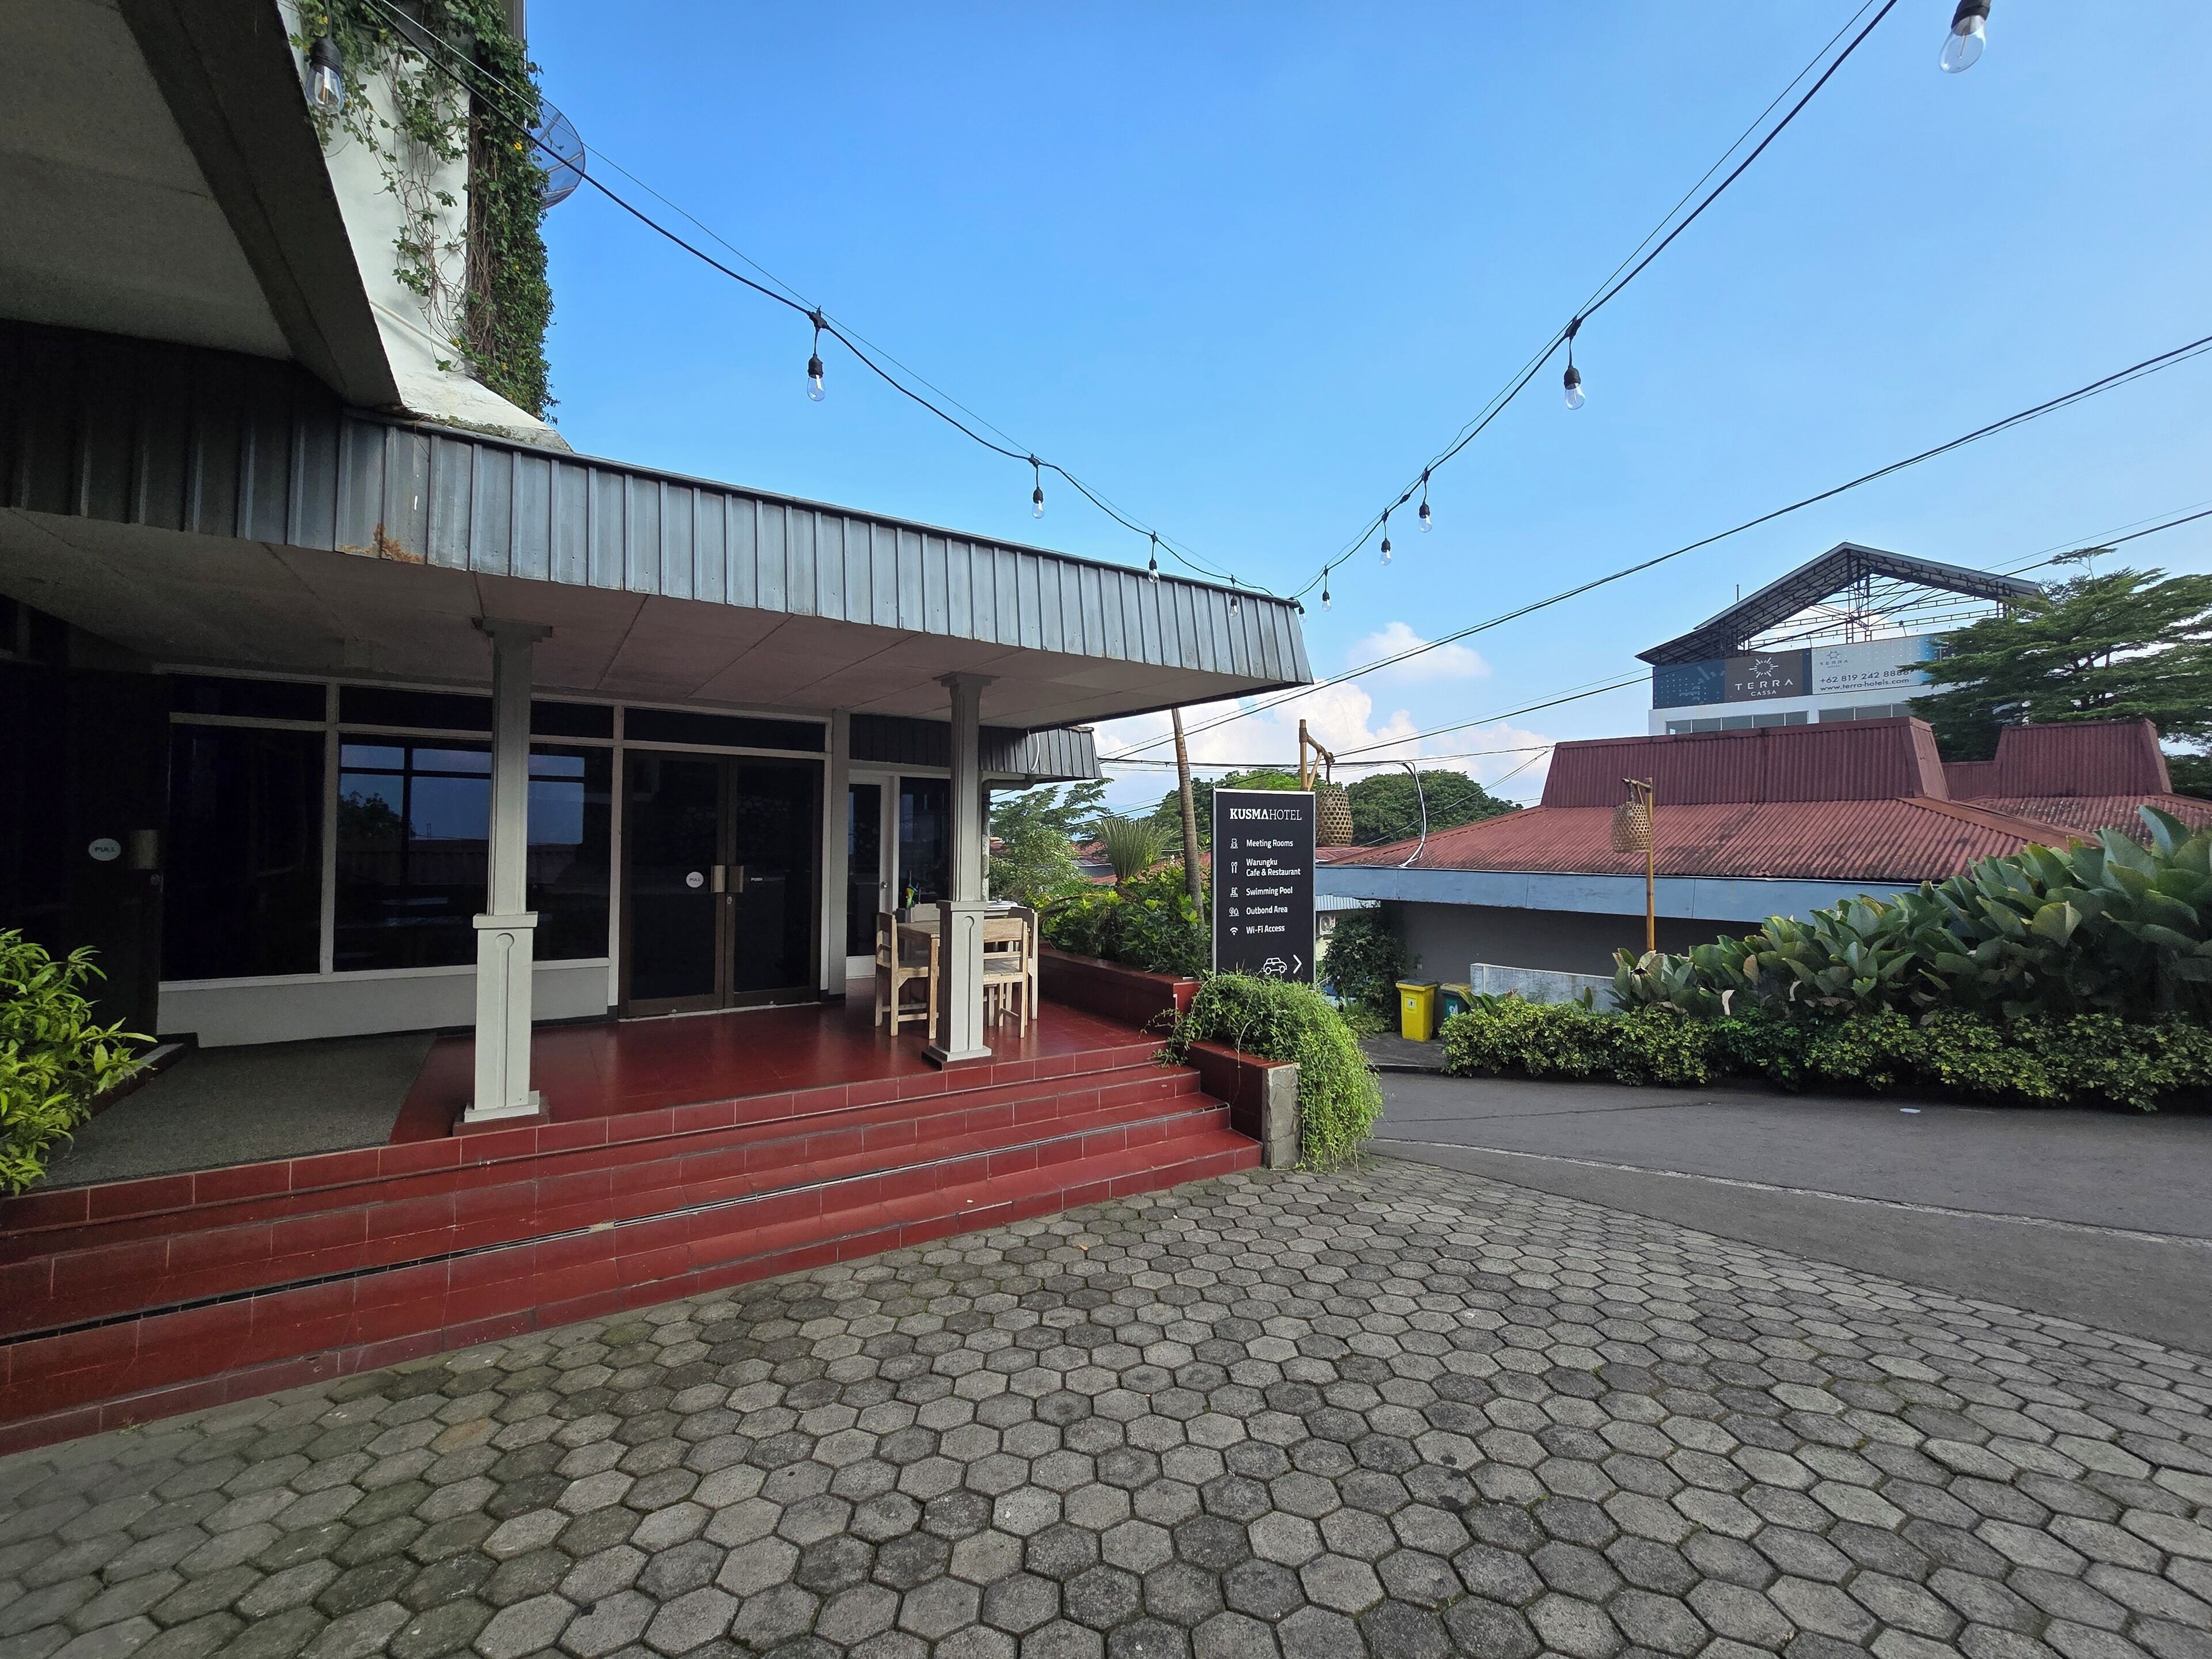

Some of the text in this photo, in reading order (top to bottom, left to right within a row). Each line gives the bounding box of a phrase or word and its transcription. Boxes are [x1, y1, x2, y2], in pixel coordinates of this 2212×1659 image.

[1734, 679, 1793, 691] TERRA
[1820, 679, 1910, 691] www.terra-hotels.com
[1246, 839, 1272, 849] Meeting
[1246, 858, 1278, 868] Warungku
[1246, 886, 1293, 896] Swimming Pool
[1246, 906, 1273, 915] Outbond
[1246, 925, 1285, 934] Wi-Fi Access
